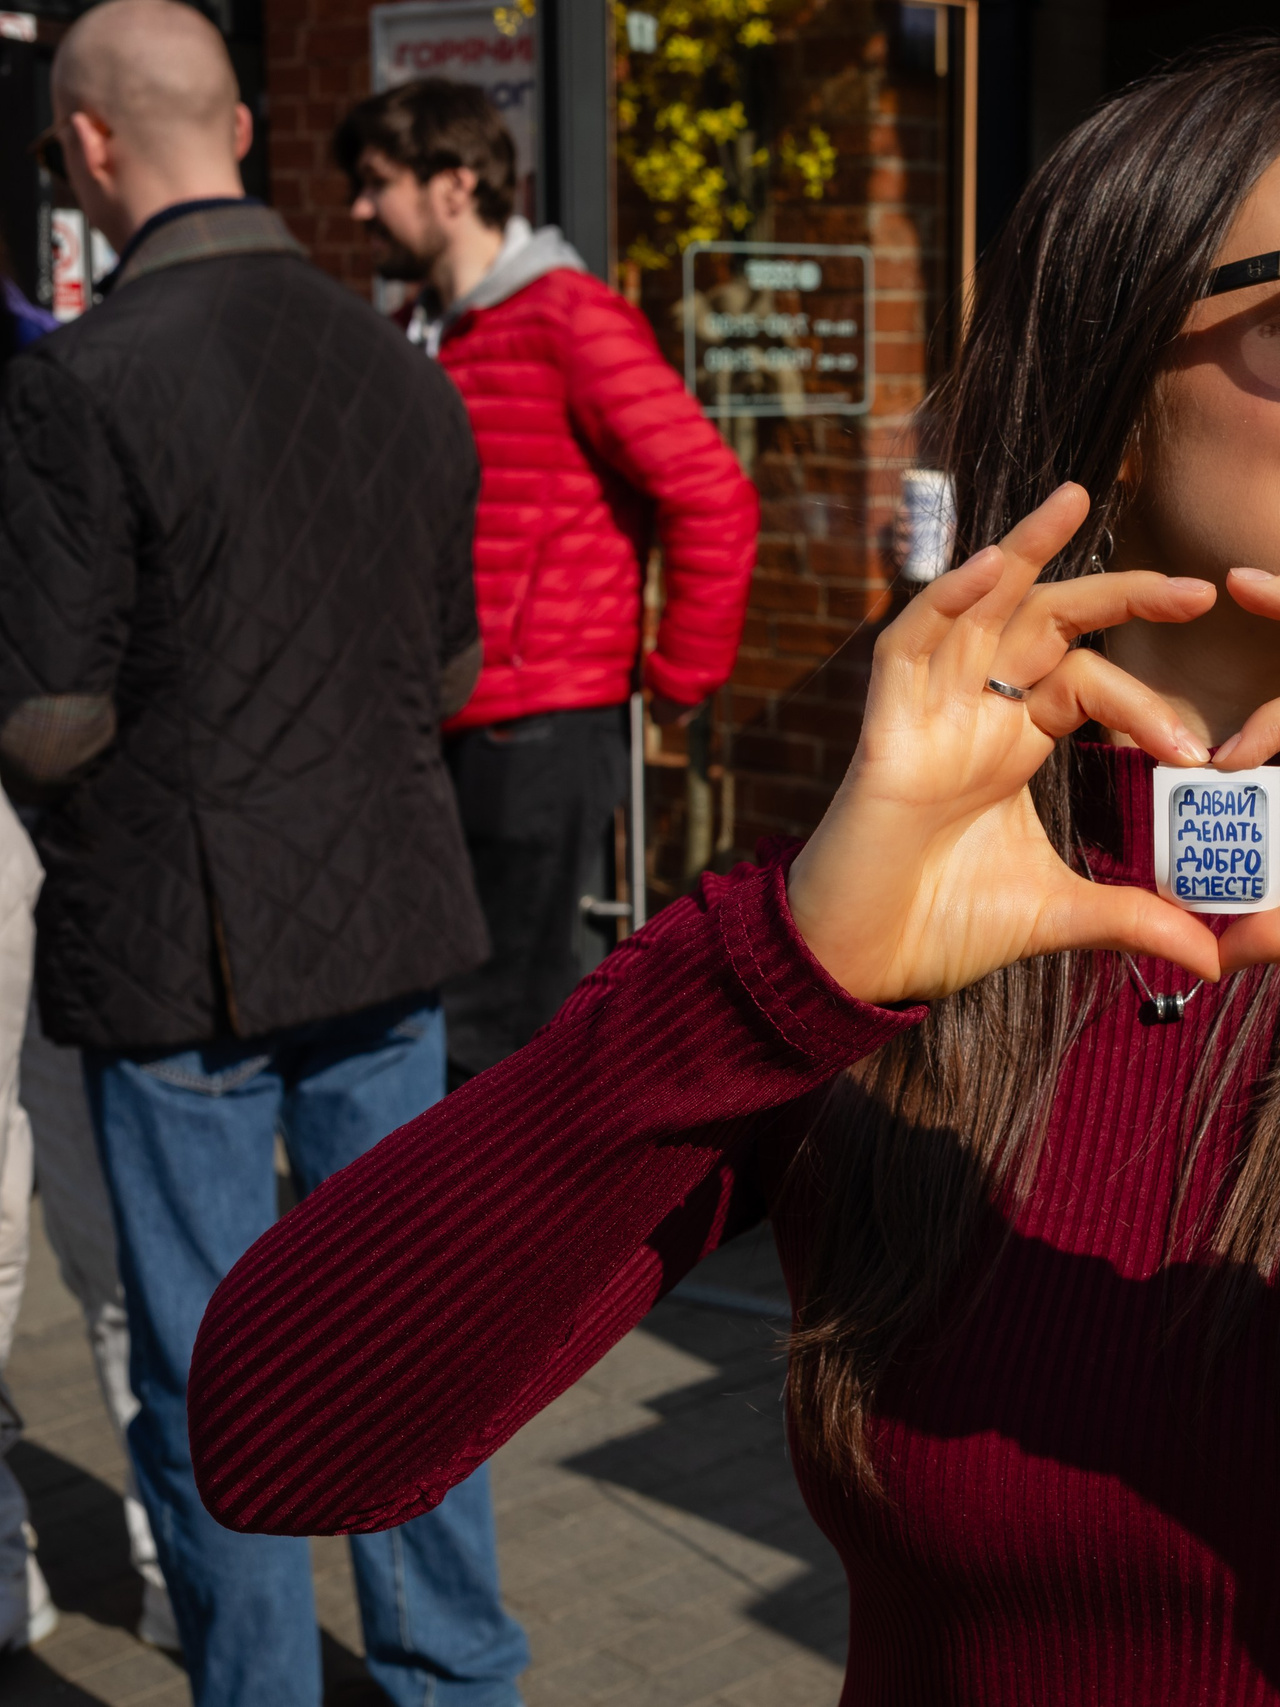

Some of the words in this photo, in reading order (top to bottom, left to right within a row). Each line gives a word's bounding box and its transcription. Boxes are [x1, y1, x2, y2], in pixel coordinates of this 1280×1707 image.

[1178, 785, 1259, 818] ДАВАЙ
[1177, 819, 1263, 843] ДЕЛАТЬ
[1176, 845, 1262, 876] ДОБРО
[1176, 876, 1264, 899] ВМЕСТЕ
